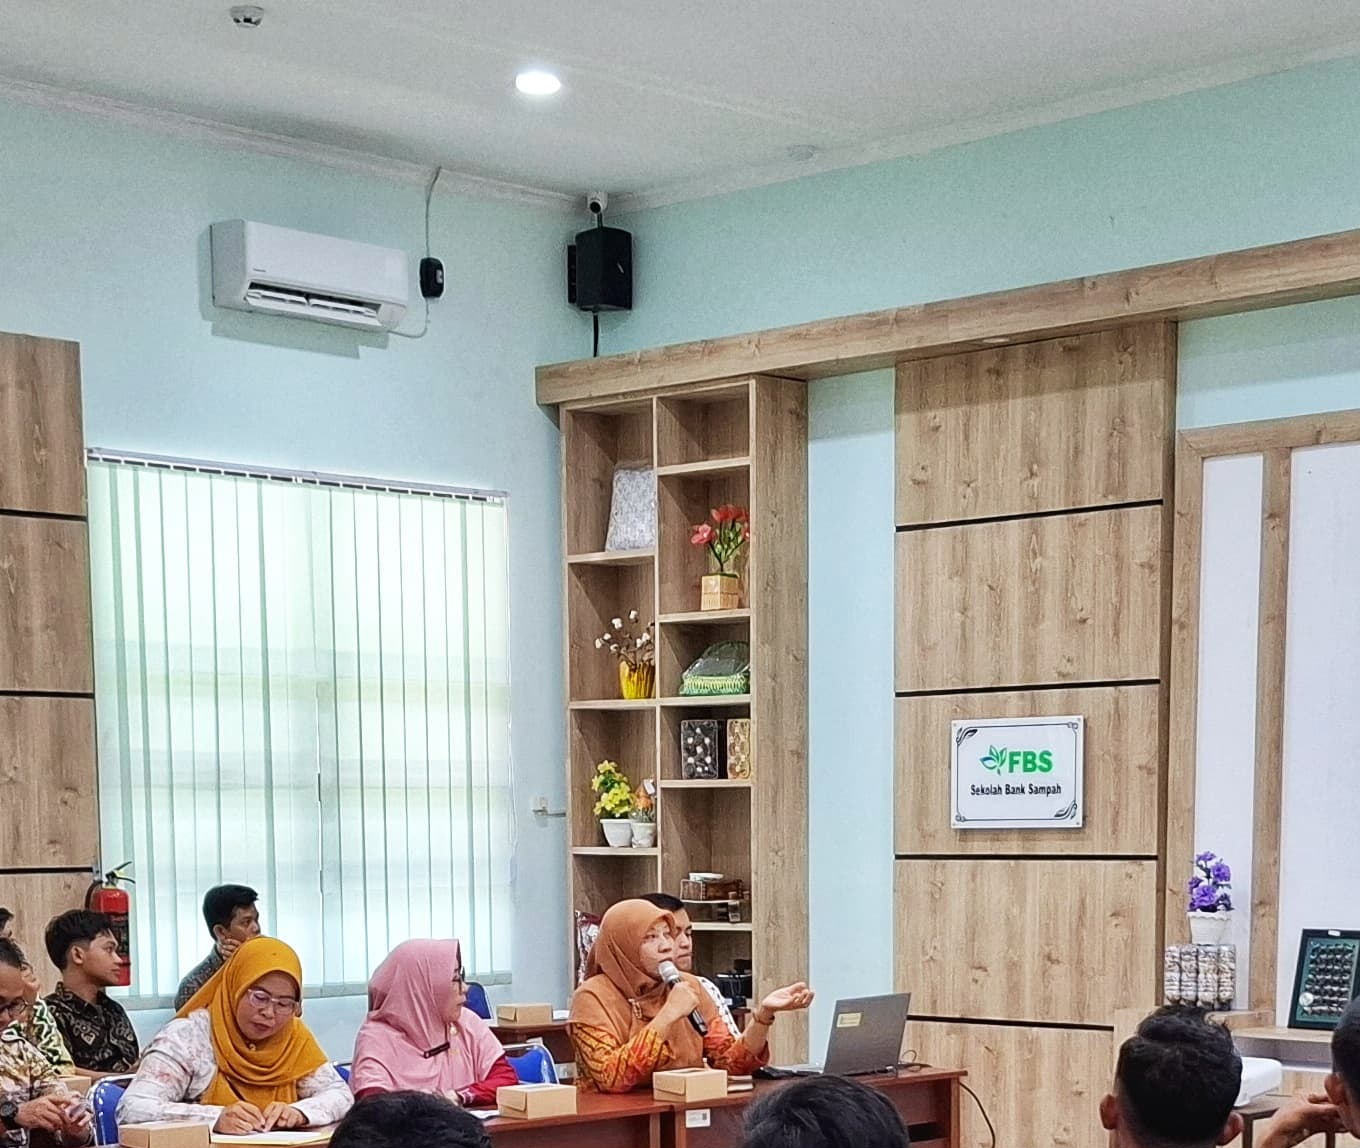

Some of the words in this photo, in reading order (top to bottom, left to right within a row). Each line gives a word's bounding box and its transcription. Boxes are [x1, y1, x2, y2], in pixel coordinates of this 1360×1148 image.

[1008, 750, 1053, 773] FBS
[970, 784, 1002, 795] Sekolah
[1005, 784, 1025, 795] Bank
[1028, 783, 1062, 797] Sampah
